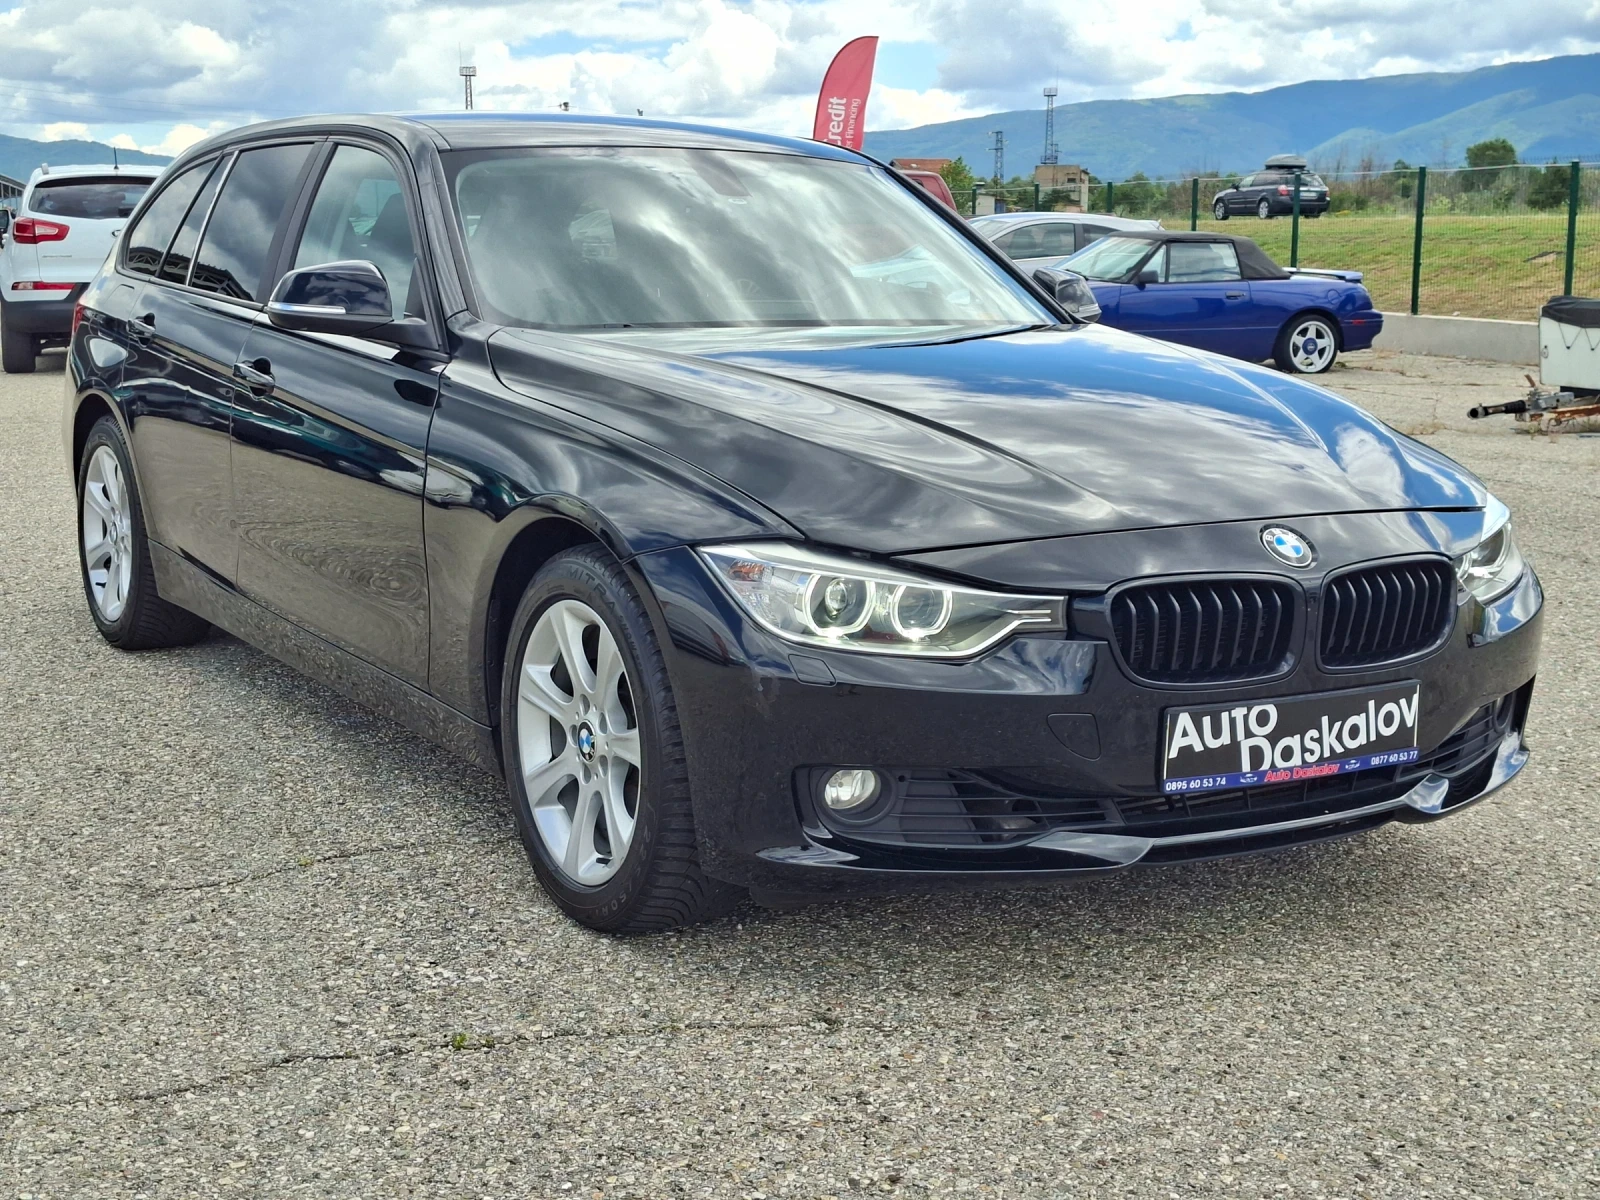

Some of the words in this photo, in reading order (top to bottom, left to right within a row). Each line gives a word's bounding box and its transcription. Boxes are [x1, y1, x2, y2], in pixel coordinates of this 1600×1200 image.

[845, 99, 861, 138] Financing
[1168, 704, 1278, 759] Auto
[1240, 693, 1419, 773] Daskalov
[1371, 755, 1388, 765] 0877
[1389, 753, 1398, 763] 60
[1399, 751, 1408, 761] 53
[1409, 750, 1418, 760] 77
[1166, 780, 1187, 791] 0895
[1190, 779, 1201, 789] 60
[1203, 777, 1213, 787] 53
[1216, 777, 1226, 786] 74
[1264, 769, 1290, 782] Auto
[1293, 763, 1340, 779] Daskalov
